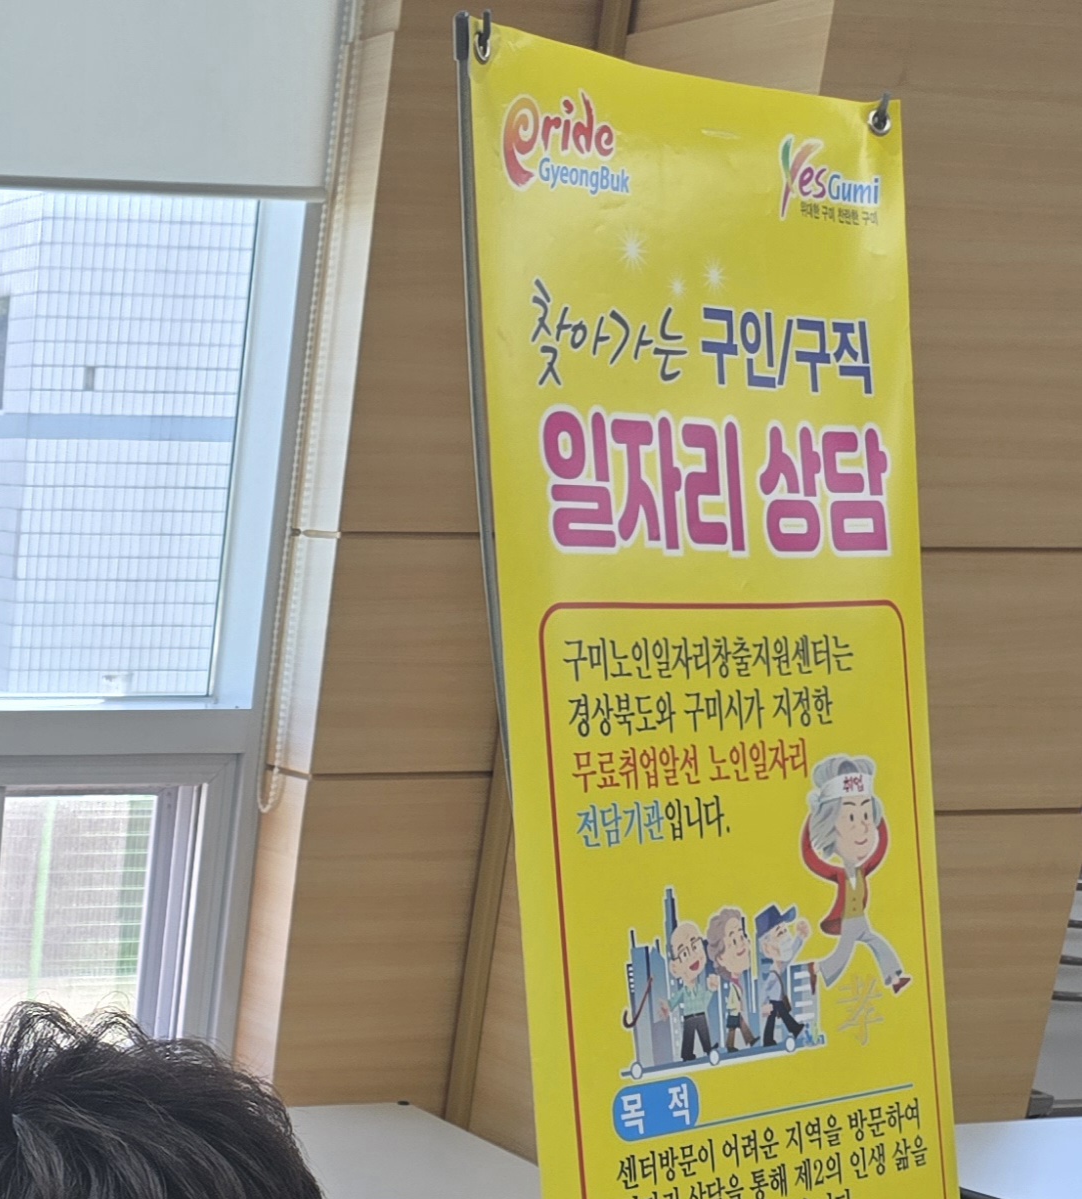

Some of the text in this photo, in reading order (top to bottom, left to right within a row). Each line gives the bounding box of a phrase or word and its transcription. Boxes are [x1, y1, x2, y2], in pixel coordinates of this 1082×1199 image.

[538, 157, 630, 195] GyeongBuk
[531, 278, 873, 395] 찾아가는 구인/구직
[542, 409, 889, 553] 일자리 상담
[563, 633, 855, 682] 구미노인일자리창출지원센터는
[568, 684, 834, 738] 경상북도와 구미시가 지정한
[571, 736, 809, 793] 무료취업알선 노인일자리
[577, 794, 732, 848] 전담기관입니다.
[616, 1097, 920, 1191] 센터방문이 어려운 지역을 방문하여
[794, 1151, 844, 1193] 제2의
[849, 1142, 887, 1181] 인생
[891, 1134, 928, 1171] 삶을
